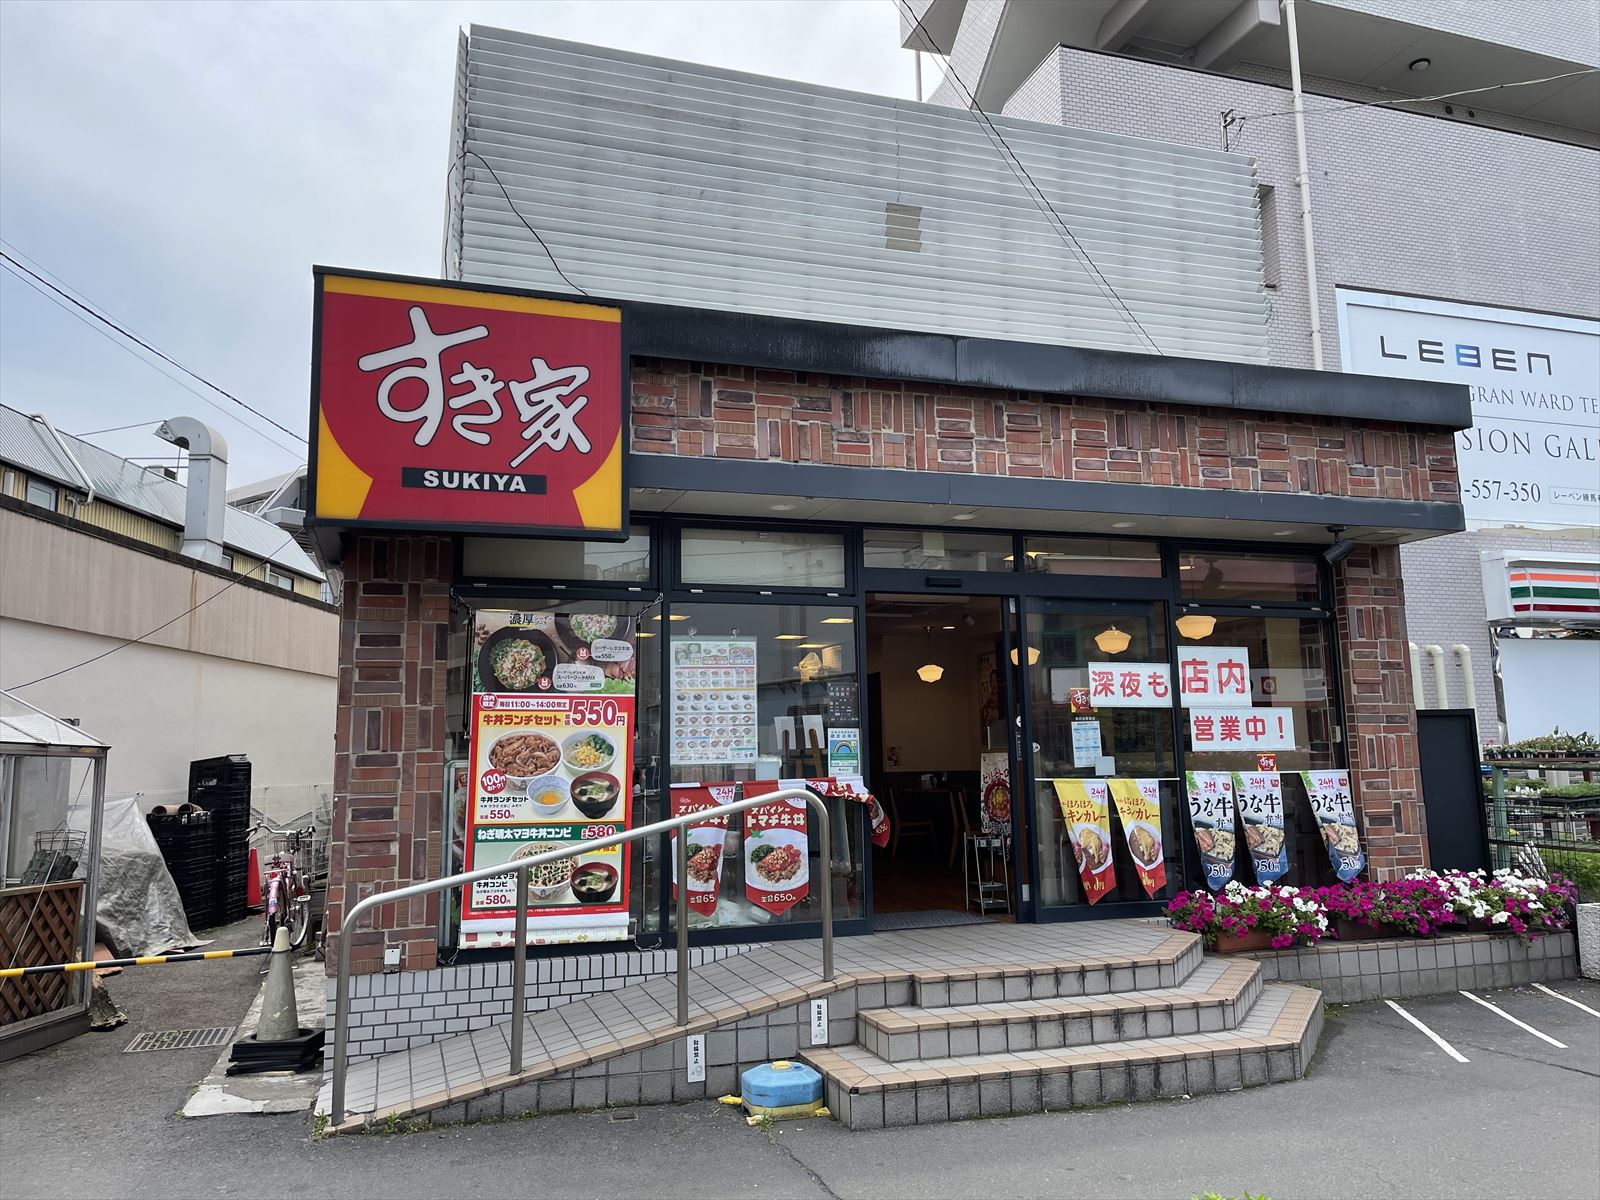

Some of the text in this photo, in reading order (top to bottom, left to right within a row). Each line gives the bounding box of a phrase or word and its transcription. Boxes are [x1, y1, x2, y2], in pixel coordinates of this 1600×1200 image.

[358, 305, 592, 469] すき家
[1520, 391, 1574, 412] WARD
[1544, 434, 1600, 461] GAL
[423, 470, 527, 493] SUKIYA
[1464, 480, 1541, 503] -557-350
[1091, 670, 1168, 698] 深夜も
[1180, 658, 1246, 694] 店内
[483, 714, 561, 726] 牛丼ランチセット
[716, 787, 733, 795] 24H
[1091, 787, 1106, 795] 24H
[1250, 777, 1265, 785] 24H
[1318, 778, 1333, 786] 24H
[1190, 796, 1233, 817] うな牛
[1238, 793, 1281, 814] うな牛
[1310, 792, 1351, 812] うな牛
[1265, 814, 1282, 824] 弁当
[476, 881, 508, 889] 牛丼コンビ
